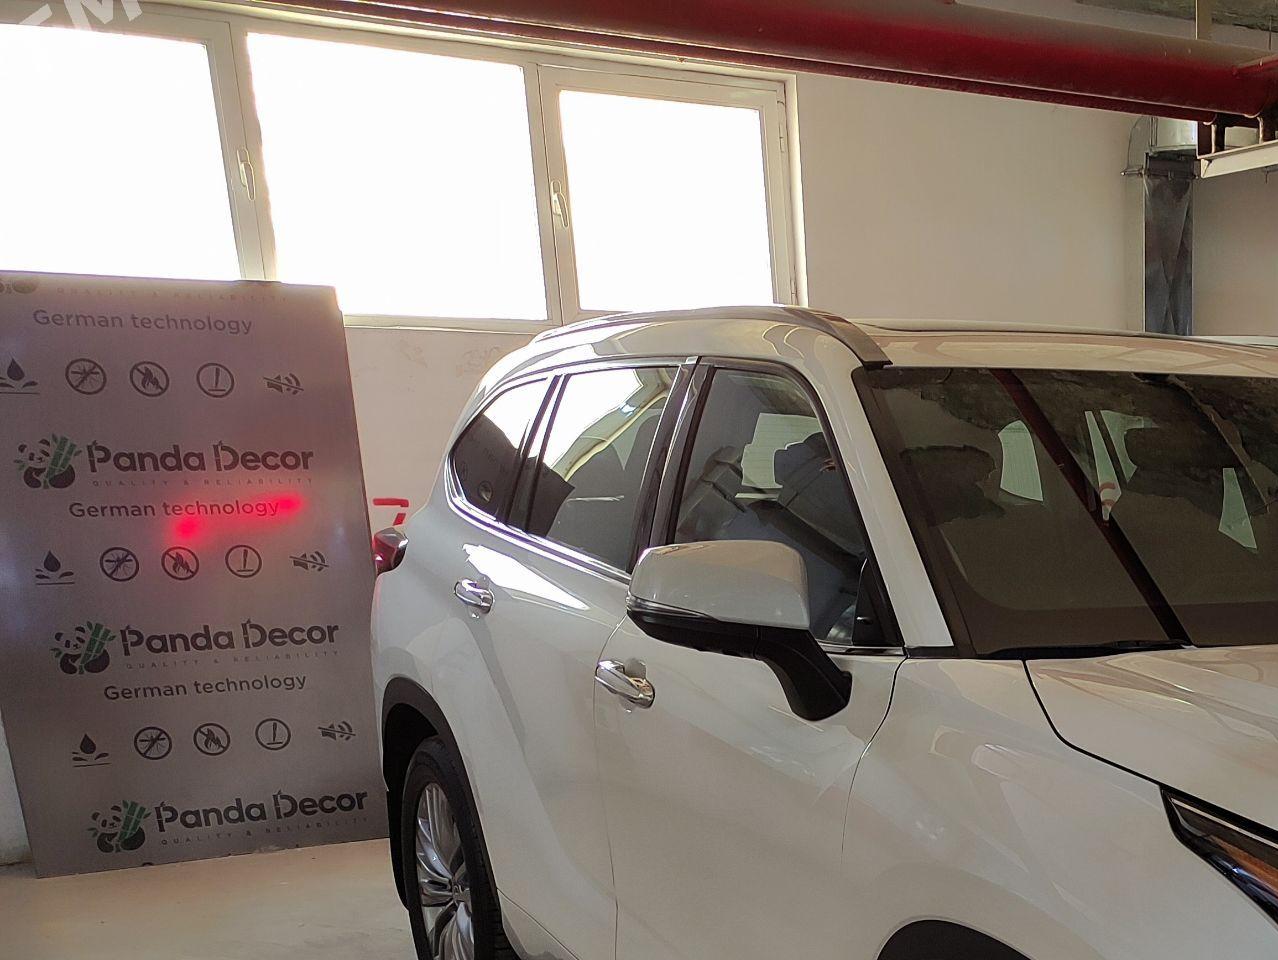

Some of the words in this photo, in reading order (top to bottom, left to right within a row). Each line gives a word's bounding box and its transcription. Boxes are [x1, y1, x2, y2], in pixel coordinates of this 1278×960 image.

[33, 309, 123, 329] German
[131, 313, 252, 335] technology
[86, 440, 206, 473] Panda
[212, 440, 314, 472] Decor
[69, 502, 156, 518] German
[162, 499, 279, 518] technology
[120, 624, 236, 656] Panda
[241, 618, 340, 649] Decor
[103, 683, 187, 700] German
[193, 675, 307, 696] technology
[154, 797, 267, 833] Panda
[272, 789, 368, 820] Decor
